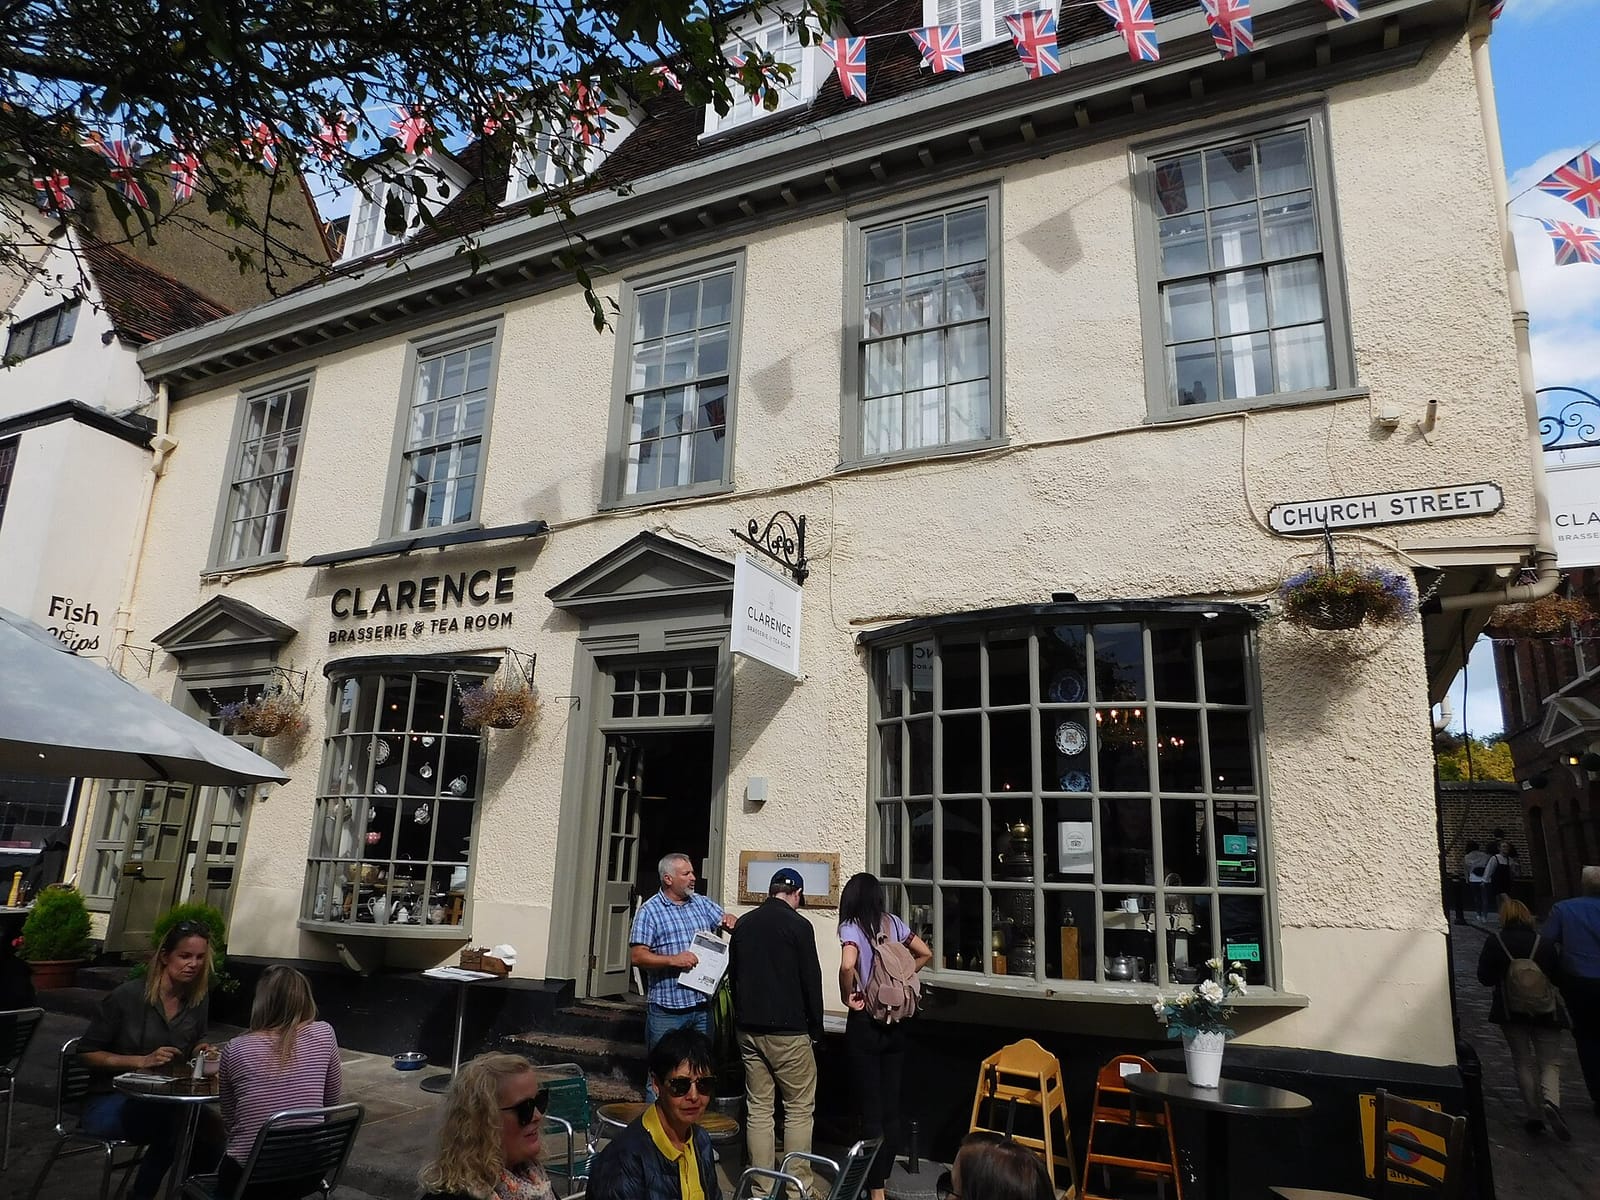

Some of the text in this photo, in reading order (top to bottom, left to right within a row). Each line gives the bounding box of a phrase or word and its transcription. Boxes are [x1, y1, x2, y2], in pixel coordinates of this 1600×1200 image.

[1282, 490, 1484, 526] CHURCH STREET
[331, 566, 517, 618] CLARENCE
[48, 595, 99, 626] Fish
[747, 606, 792, 638] CLARENCE
[328, 612, 513, 644] BRASSERIE & TEA ROOM
